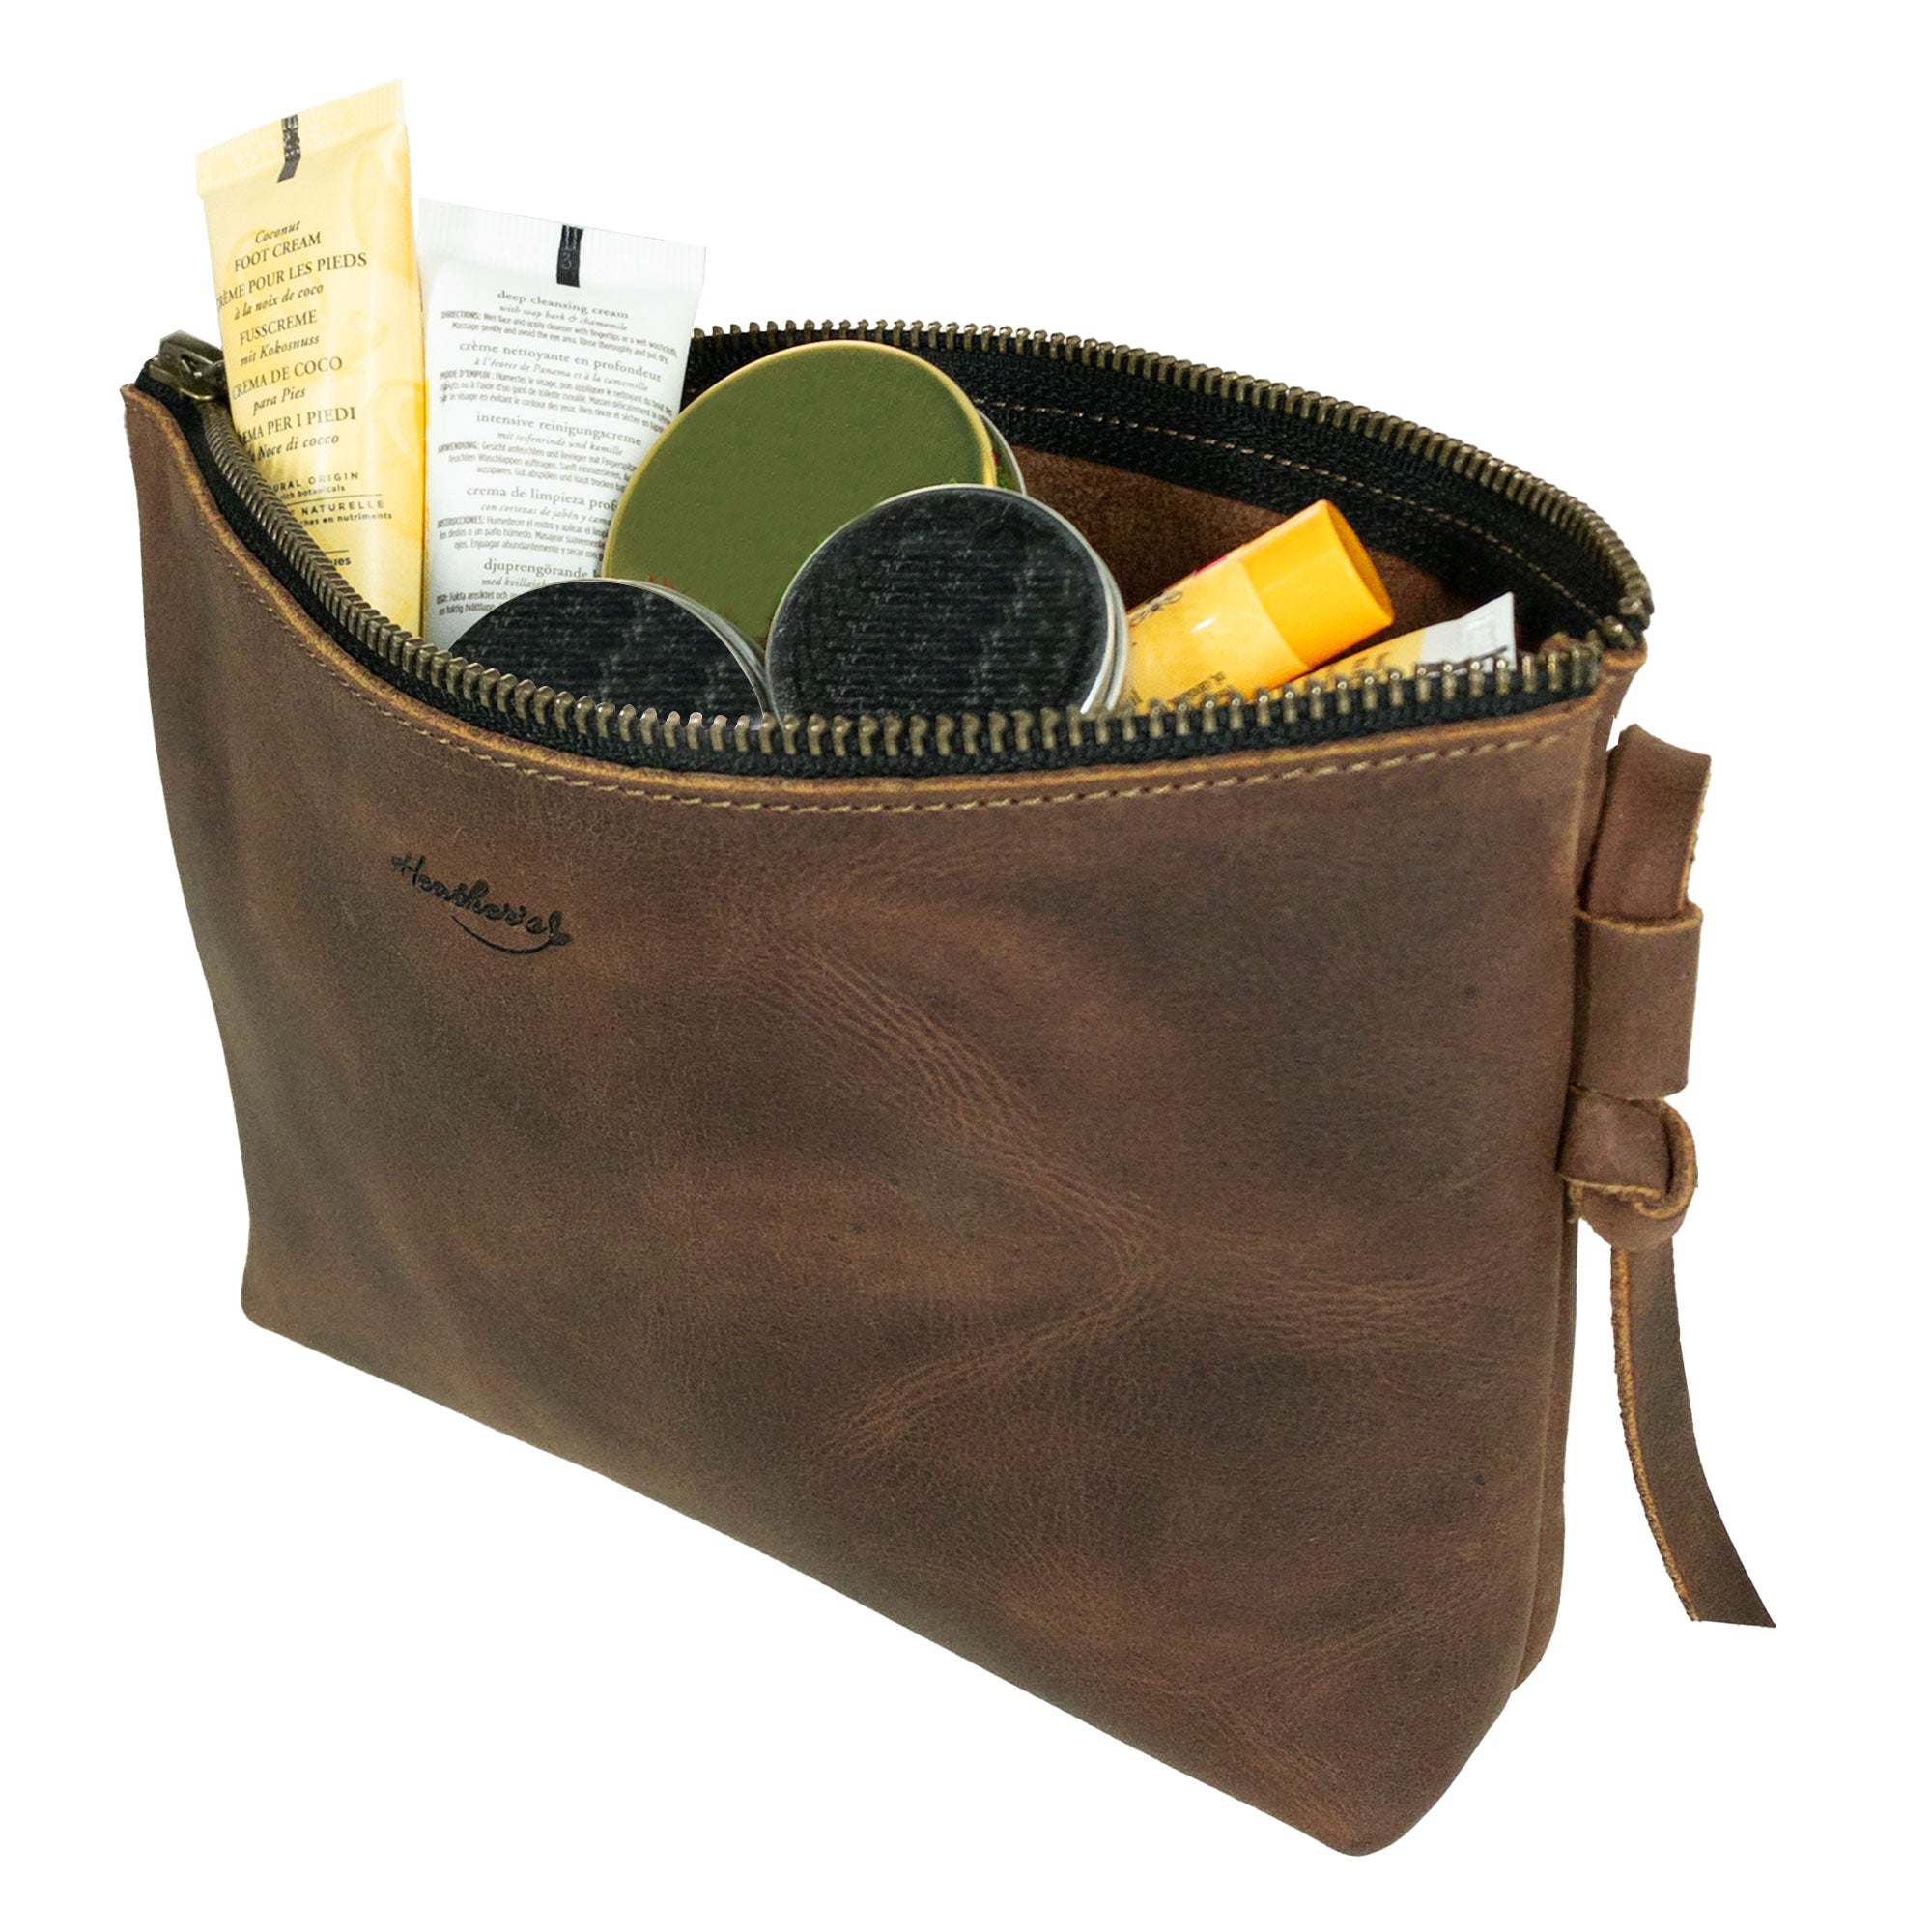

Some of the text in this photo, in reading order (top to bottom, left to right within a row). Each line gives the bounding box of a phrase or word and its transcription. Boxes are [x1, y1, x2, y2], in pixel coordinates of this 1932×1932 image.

[255, 220, 300, 243] Coconut
[234, 231, 321, 272] FOOT CREAM
[248, 270, 285, 294] POUR
[289, 261, 312, 280] LES
[317, 252, 367, 272] PIEDS
[234, 284, 324, 321] à la noix de coco
[497, 290, 629, 319] deep cleansing cream
[240, 309, 318, 346] FUSSCREME
[240, 335, 320, 367] mit Kokosnuss
[459, 341, 498, 353] crème
[503, 348, 570, 362] nettoyante
[593, 361, 662, 382] profondeur
[232, 355, 343, 400] CREMA DE COCO
[252, 387, 306, 416] para Pies
[268, 415, 293, 435] PER
[297, 413, 302, 427] I
[307, 406, 356, 425] PIEDI
[476, 412, 641, 445] intensive reinigungscreme
[257, 445, 282, 461] Noce
[286, 436, 298, 451] di
[302, 435, 339, 448] cocco
[298, 484, 346, 497] botanicals
[308, 471, 359, 484] ORIGIN
[301, 500, 384, 516] NATURELLE
[467, 487, 507, 497] crema
[511, 487, 526, 497] de
[530, 488, 584, 505] limpieza
[337, 511, 393, 523] nutriments
[481, 577, 502, 587] med
[483, 558, 588, 579] djuprengörande
